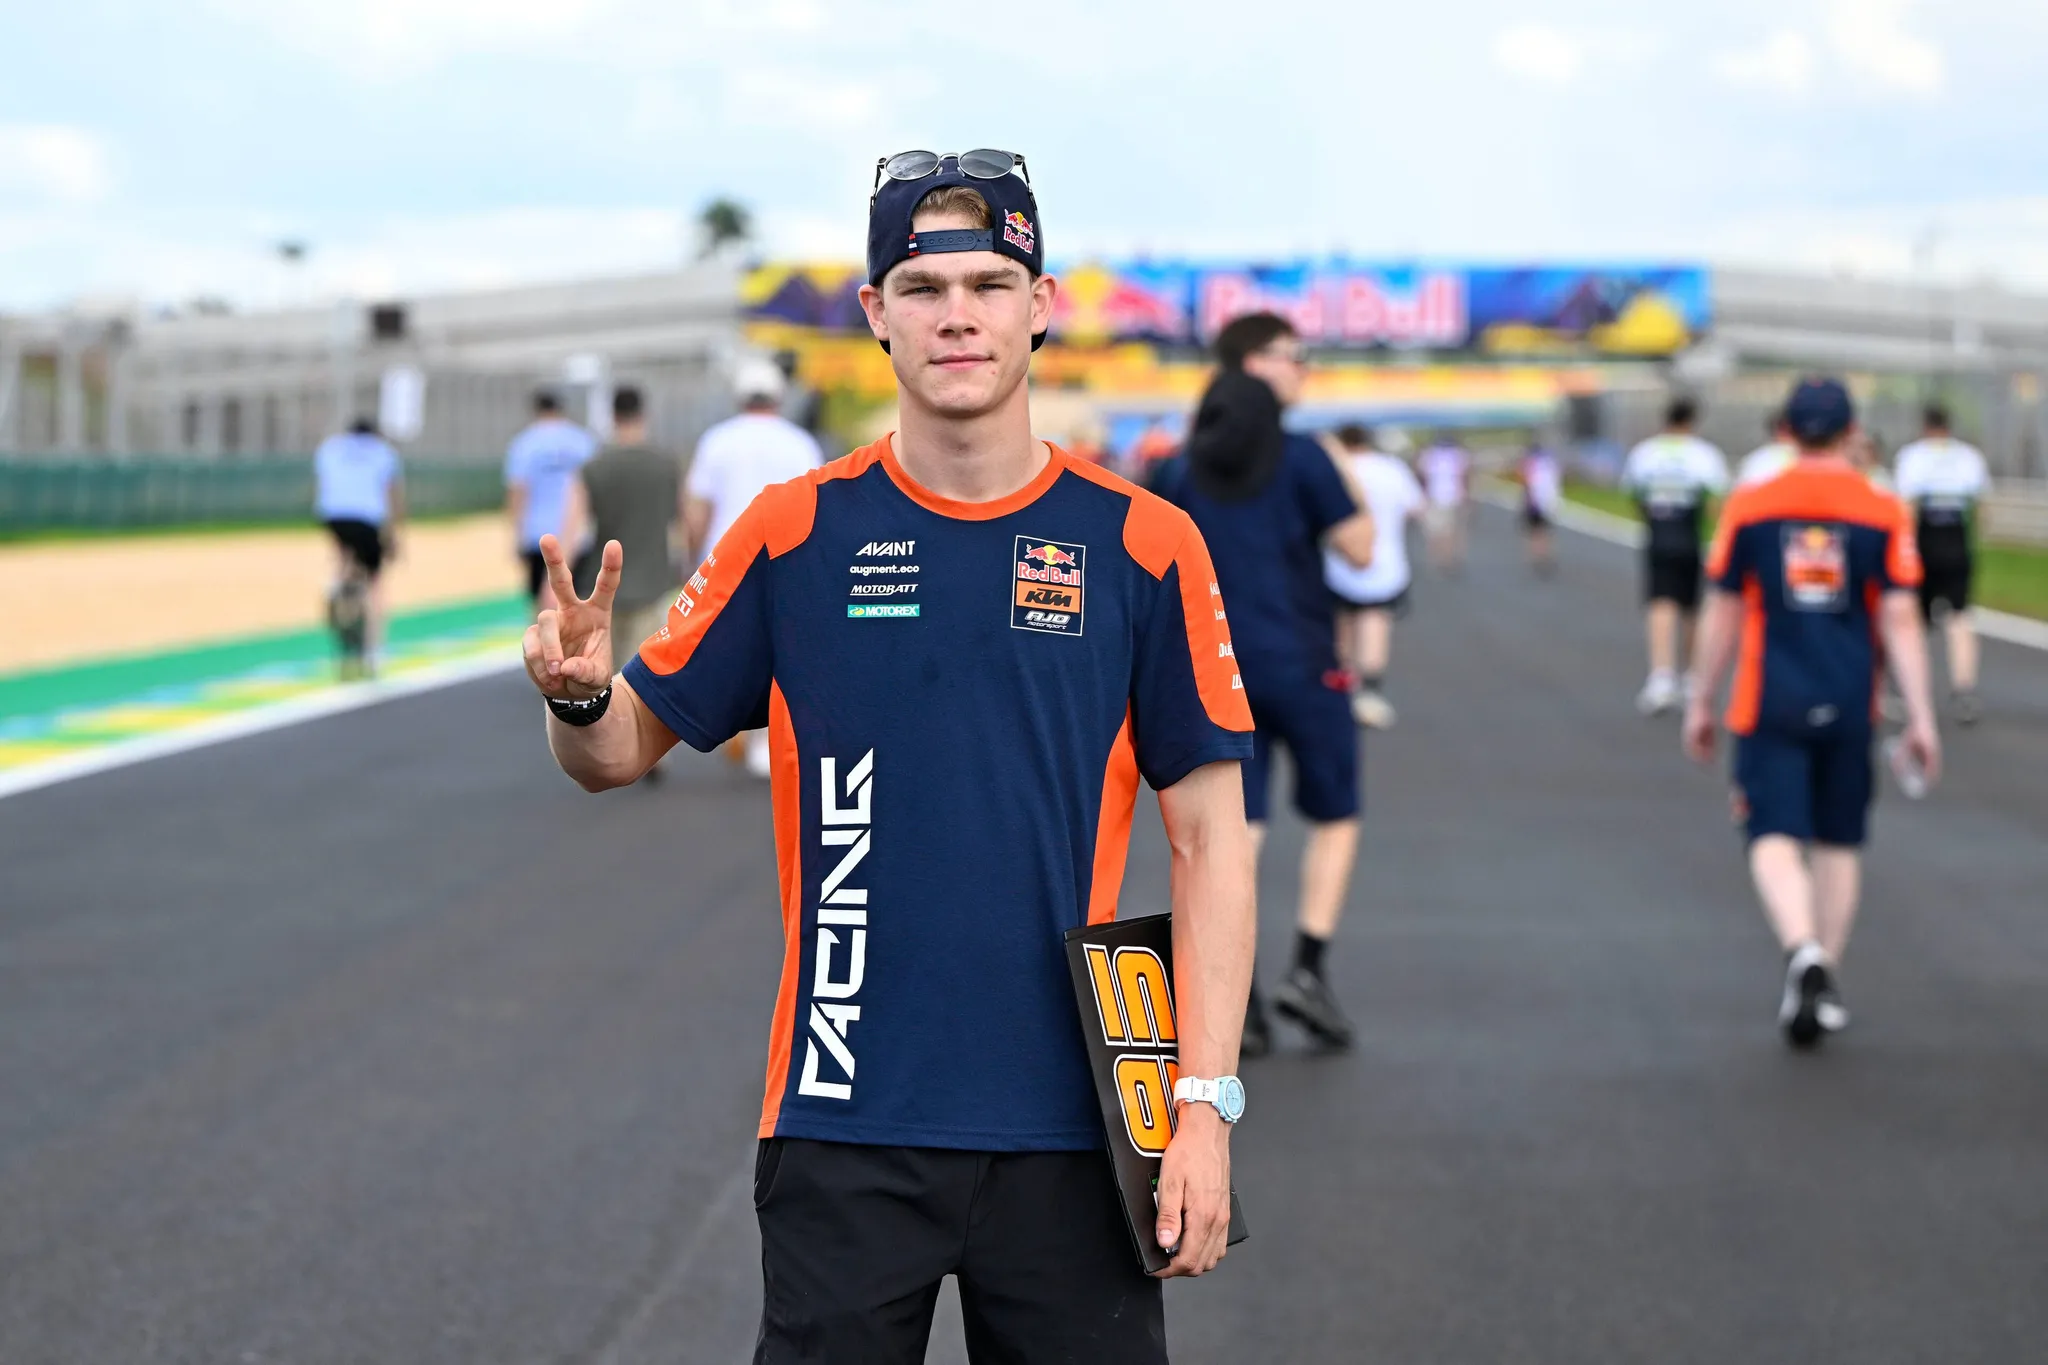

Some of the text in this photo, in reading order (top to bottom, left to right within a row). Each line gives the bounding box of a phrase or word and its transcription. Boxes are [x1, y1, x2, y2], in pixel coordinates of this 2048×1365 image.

[1003, 226, 1034, 254] Red Bull
[855, 541, 915, 556] AVANT
[849, 564, 920, 577] augment.eco
[1017, 561, 1081, 587] Red Bull
[849, 583, 919, 596] MOTOBATT
[1024, 588, 1072, 608] KTM
[865, 605, 917, 617] MOTOREX
[1024, 610, 1071, 625] AJO
[798, 747, 874, 1100] RACING
[1083, 943, 1180, 1158] 95
